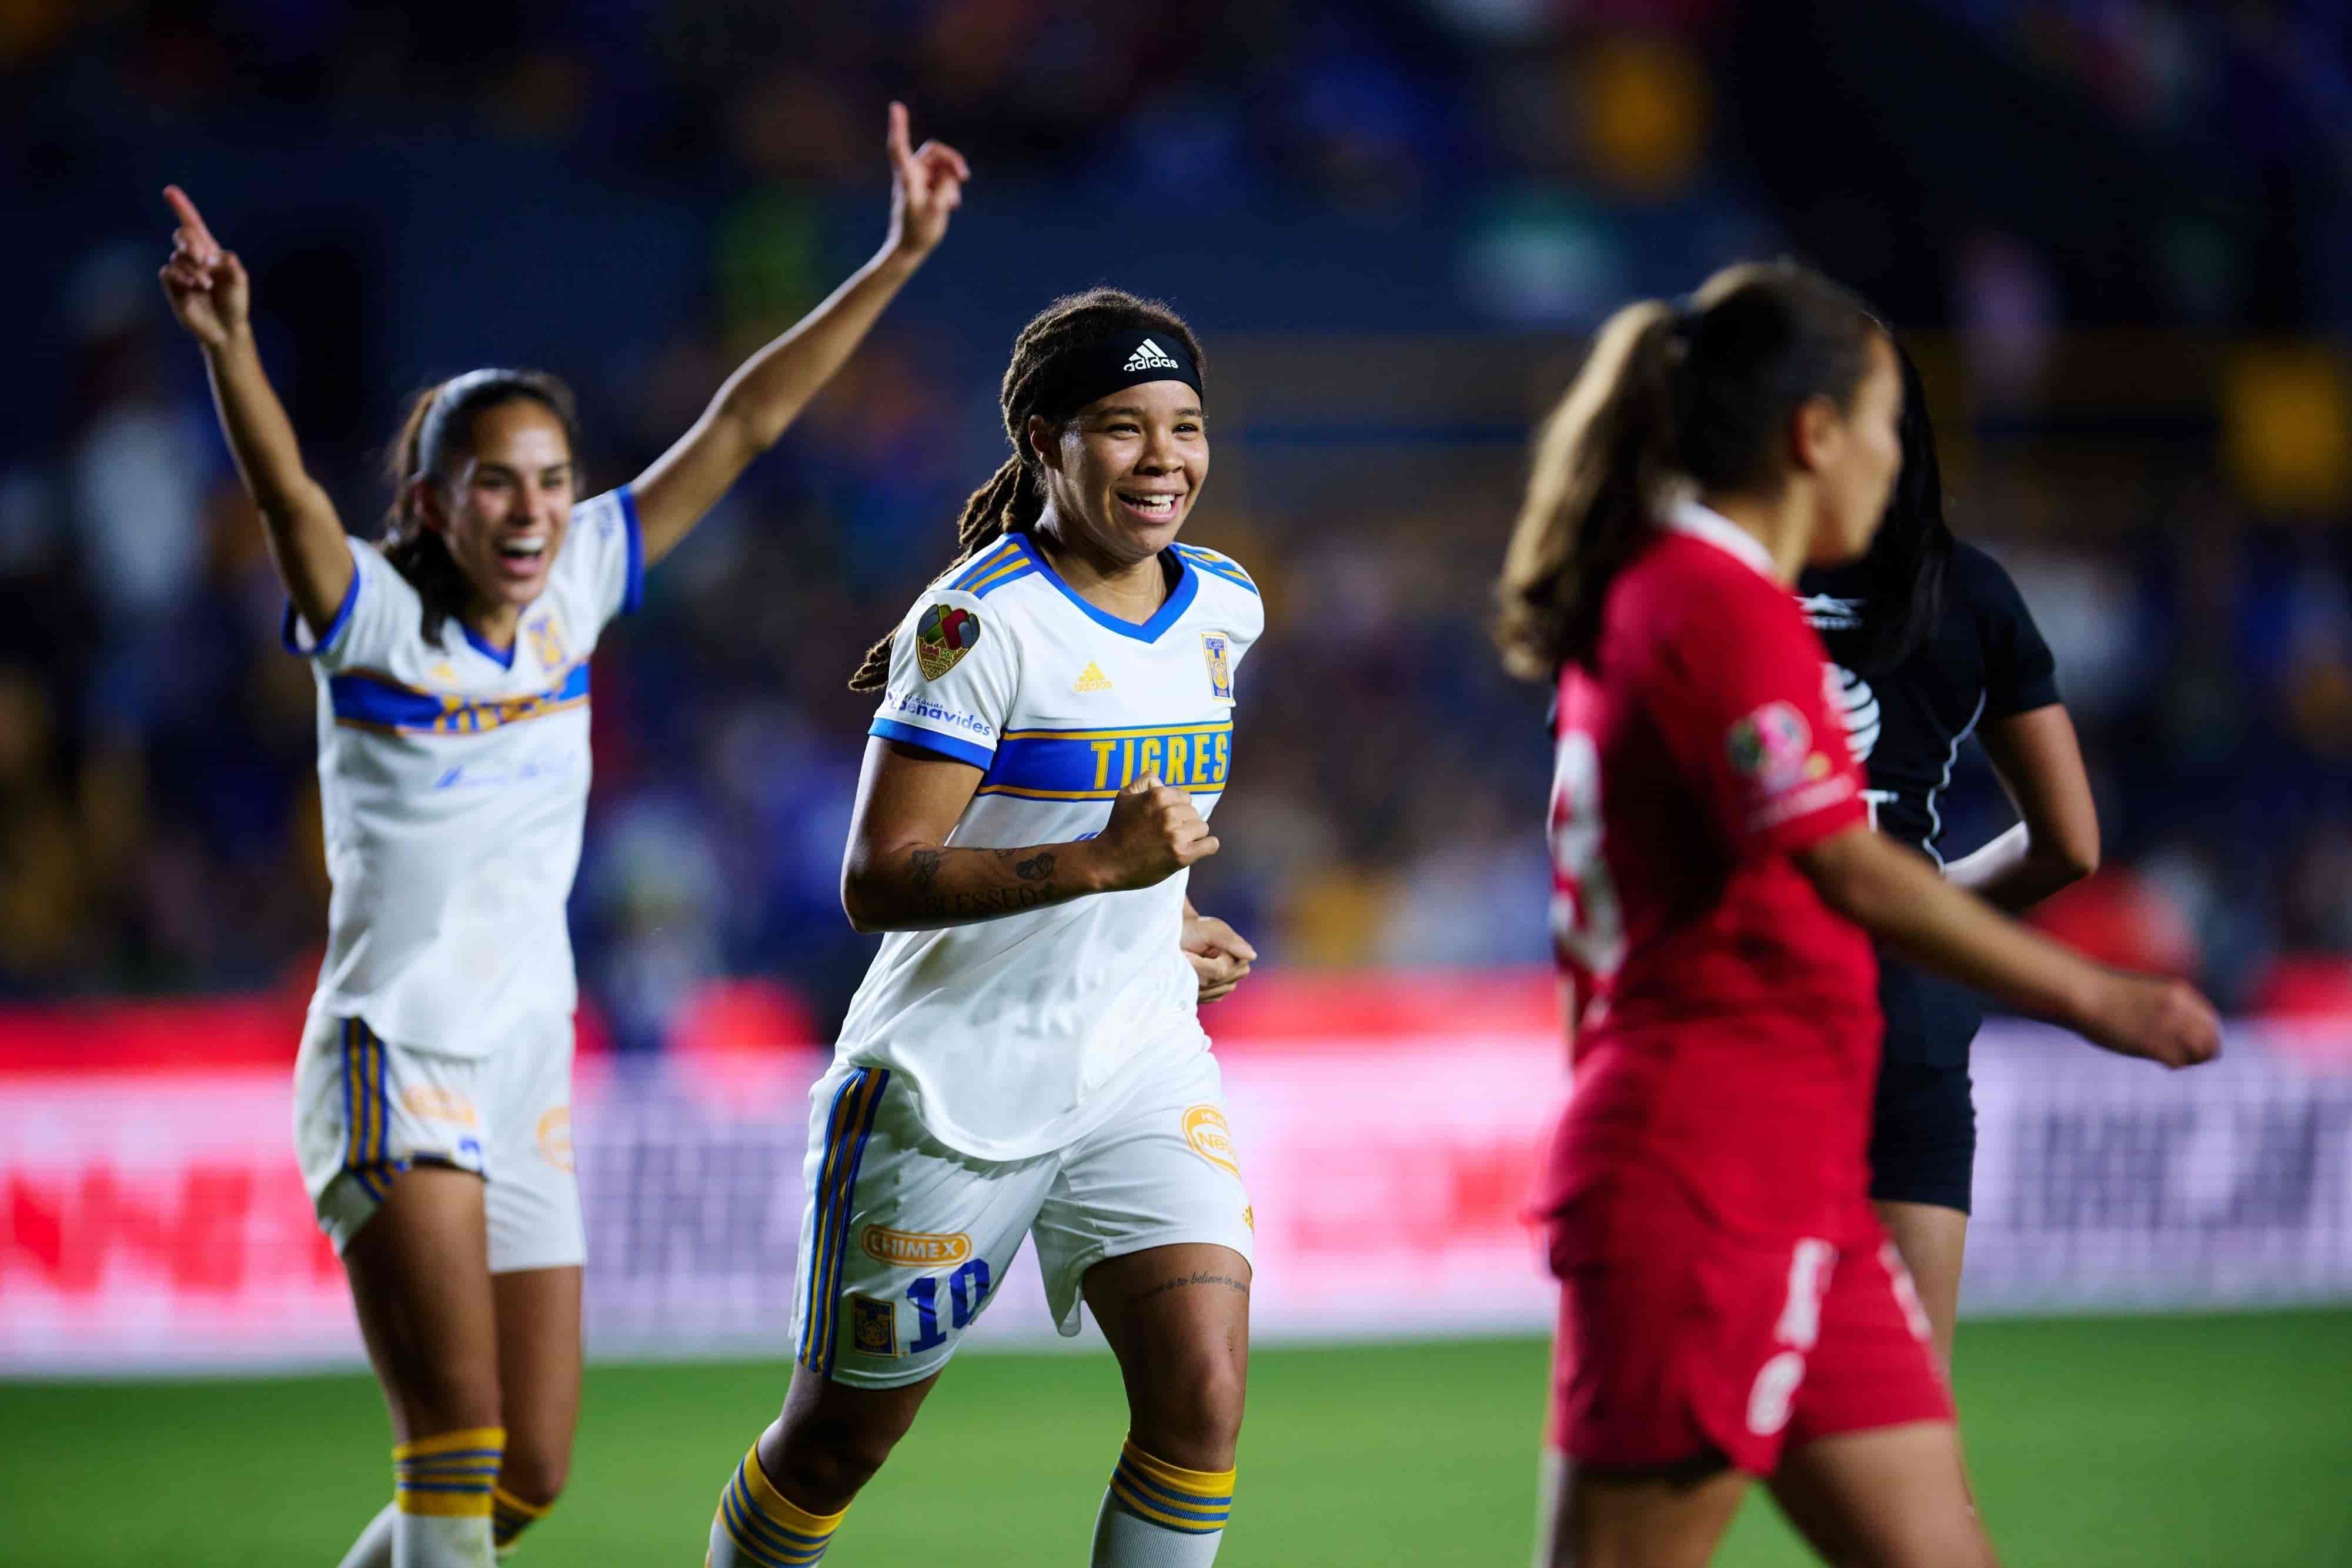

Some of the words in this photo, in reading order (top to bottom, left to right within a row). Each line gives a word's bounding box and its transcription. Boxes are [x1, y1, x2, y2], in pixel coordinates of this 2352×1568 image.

[1124, 357, 1178, 372] adidas
[1091, 733, 1228, 790] TIGRES
[872, 1235, 958, 1258] CHIMEX
[907, 1258, 990, 1355] 10
